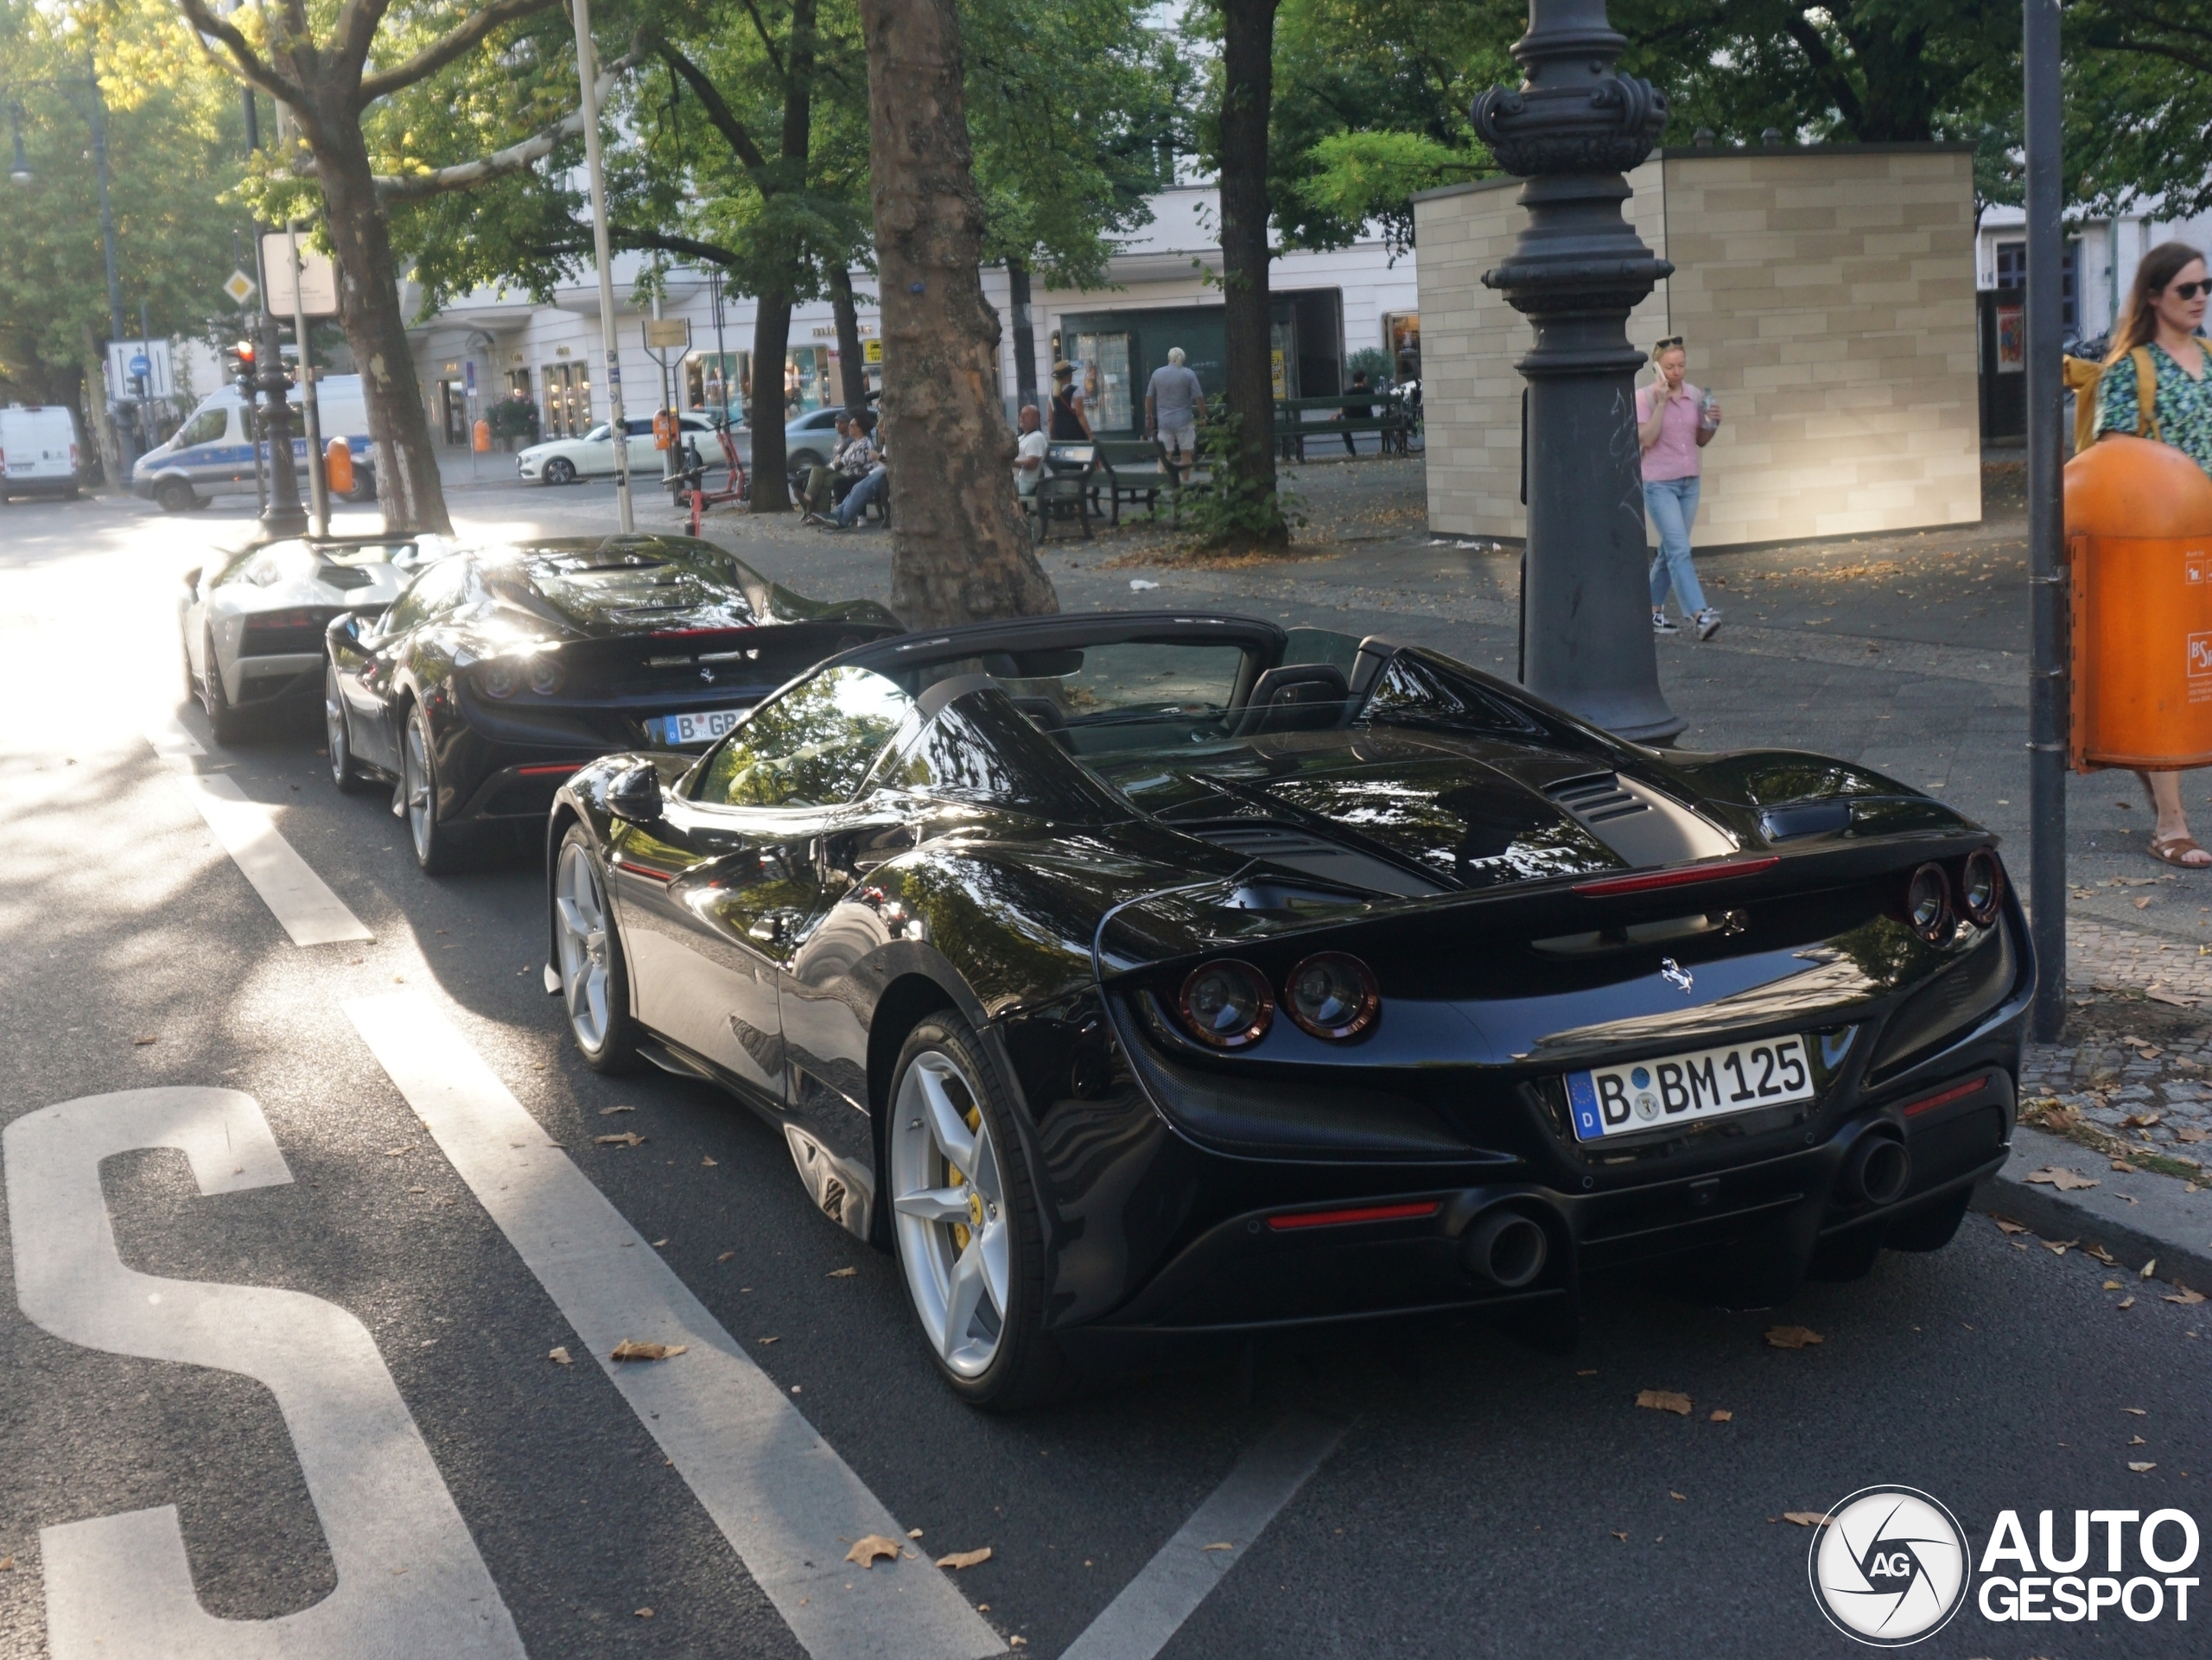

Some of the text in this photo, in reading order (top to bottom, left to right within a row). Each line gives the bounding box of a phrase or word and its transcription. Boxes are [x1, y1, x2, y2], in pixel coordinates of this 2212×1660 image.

[678, 717, 695, 739] B
[1597, 1073, 1630, 1126] B
[1582, 1111, 1594, 1128] D
